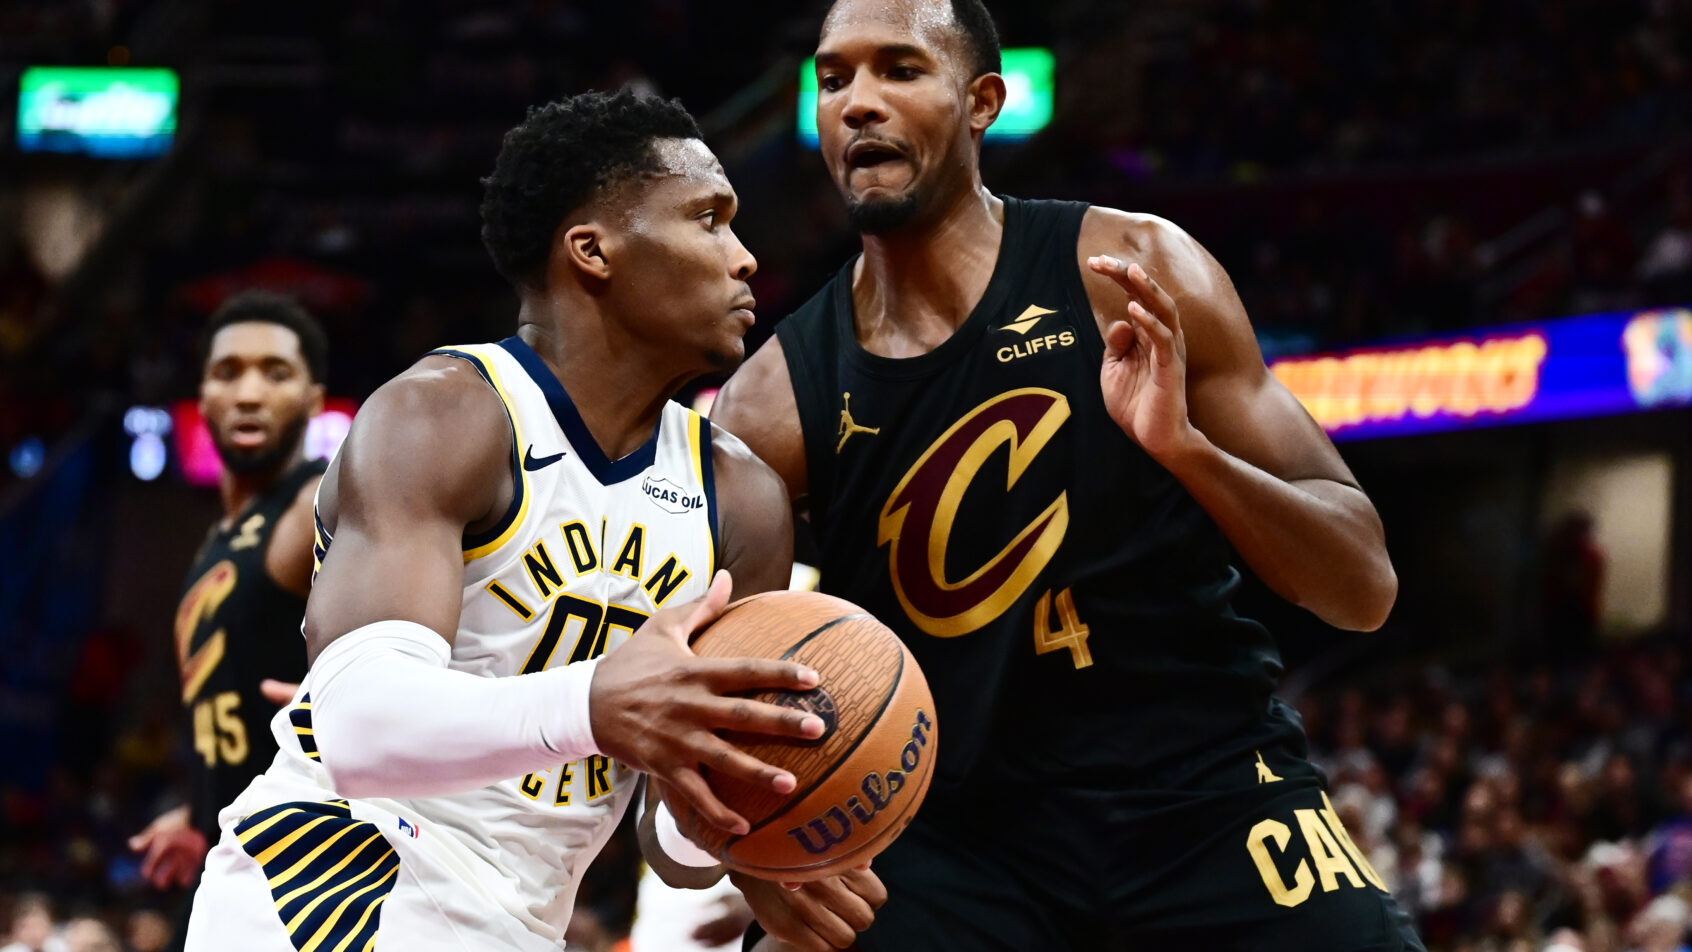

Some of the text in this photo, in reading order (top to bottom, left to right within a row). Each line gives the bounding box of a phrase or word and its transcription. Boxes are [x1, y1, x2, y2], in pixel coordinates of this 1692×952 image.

[997, 331, 1075, 363] CLIFFS
[681, 495, 703, 509] OIL
[877, 387, 1072, 638] C
[1033, 586, 1094, 670] 4
[194, 691, 248, 768] 45
[787, 708, 932, 854] Wilson
